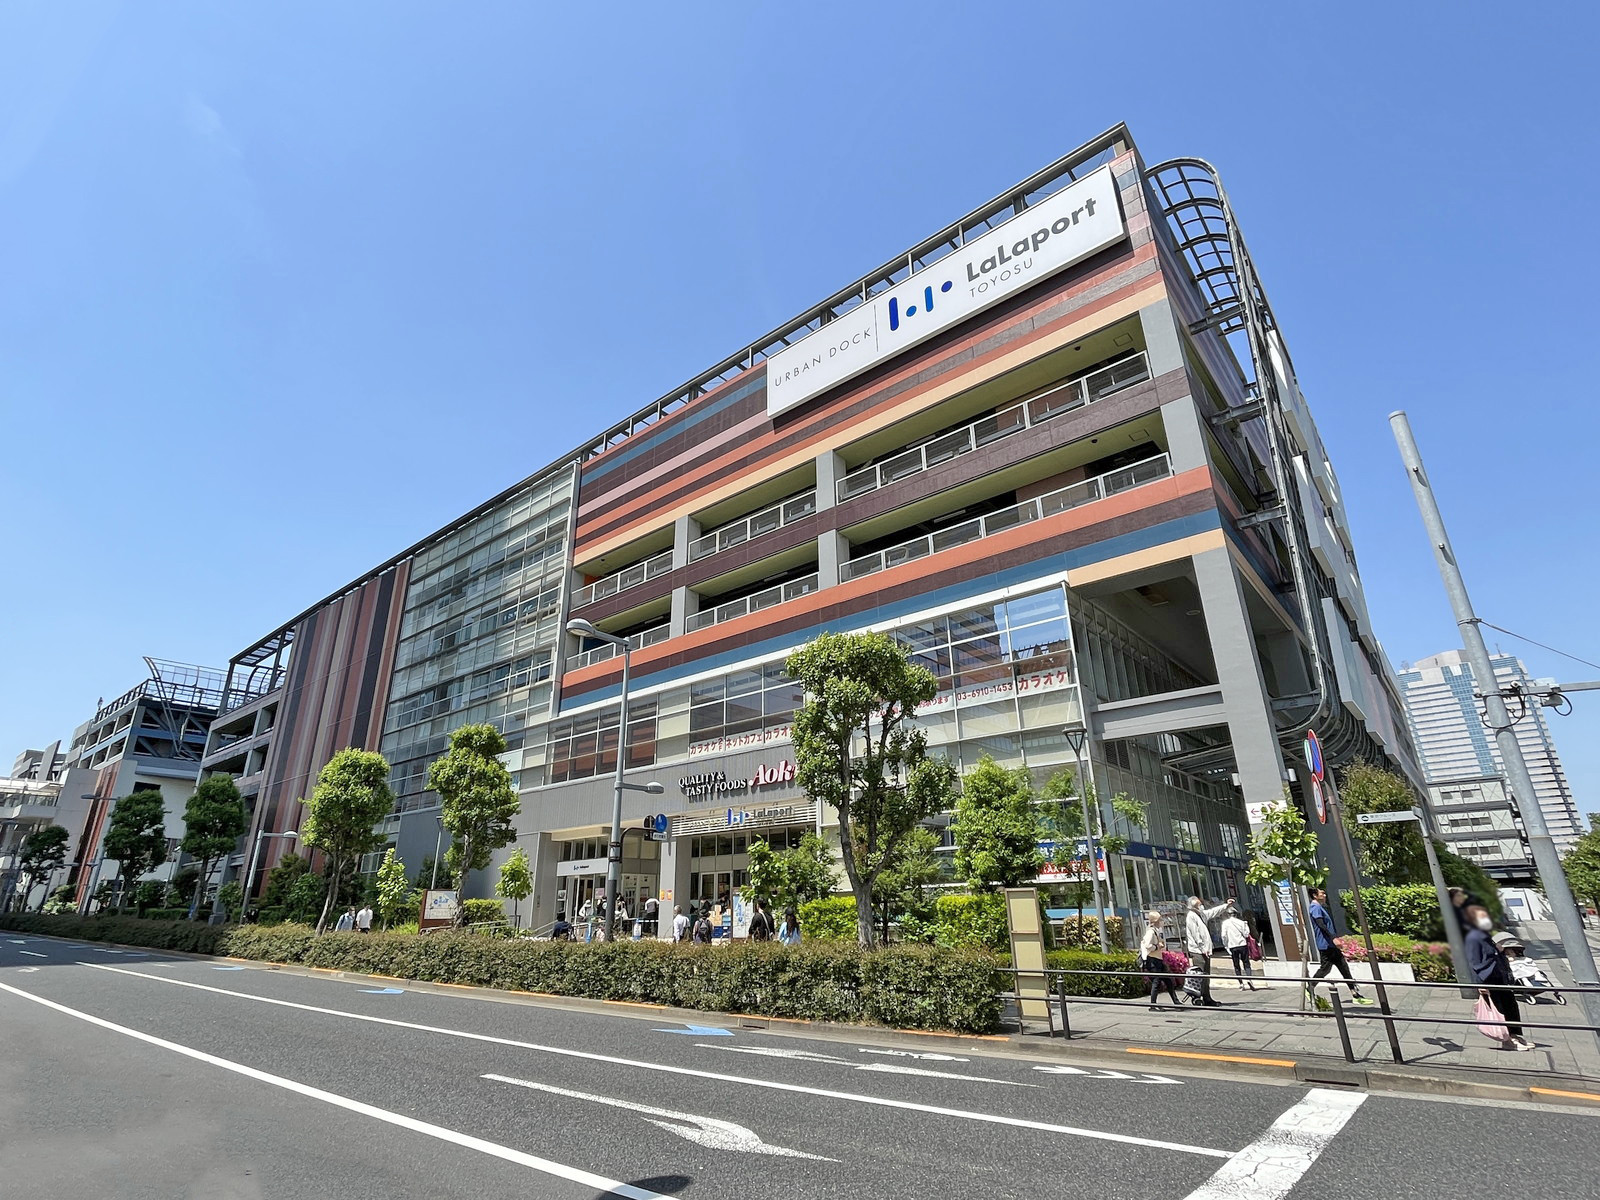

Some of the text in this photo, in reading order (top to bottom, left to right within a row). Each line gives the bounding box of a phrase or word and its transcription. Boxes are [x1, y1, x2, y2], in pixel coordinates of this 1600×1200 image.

[966, 197, 1097, 282] LaLaport
[969, 257, 1034, 298] TOYOSU
[774, 327, 872, 387] URBAN DOCK
[956, 682, 1013, 701] 03-6910-1453
[1018, 671, 1067, 691] カラオケ
[690, 741, 718, 755] カラオケ
[726, 732, 763, 749] ネットカフェ
[685, 779, 747, 796] TASTY FOODS
[753, 806, 793, 819] LaLaport
